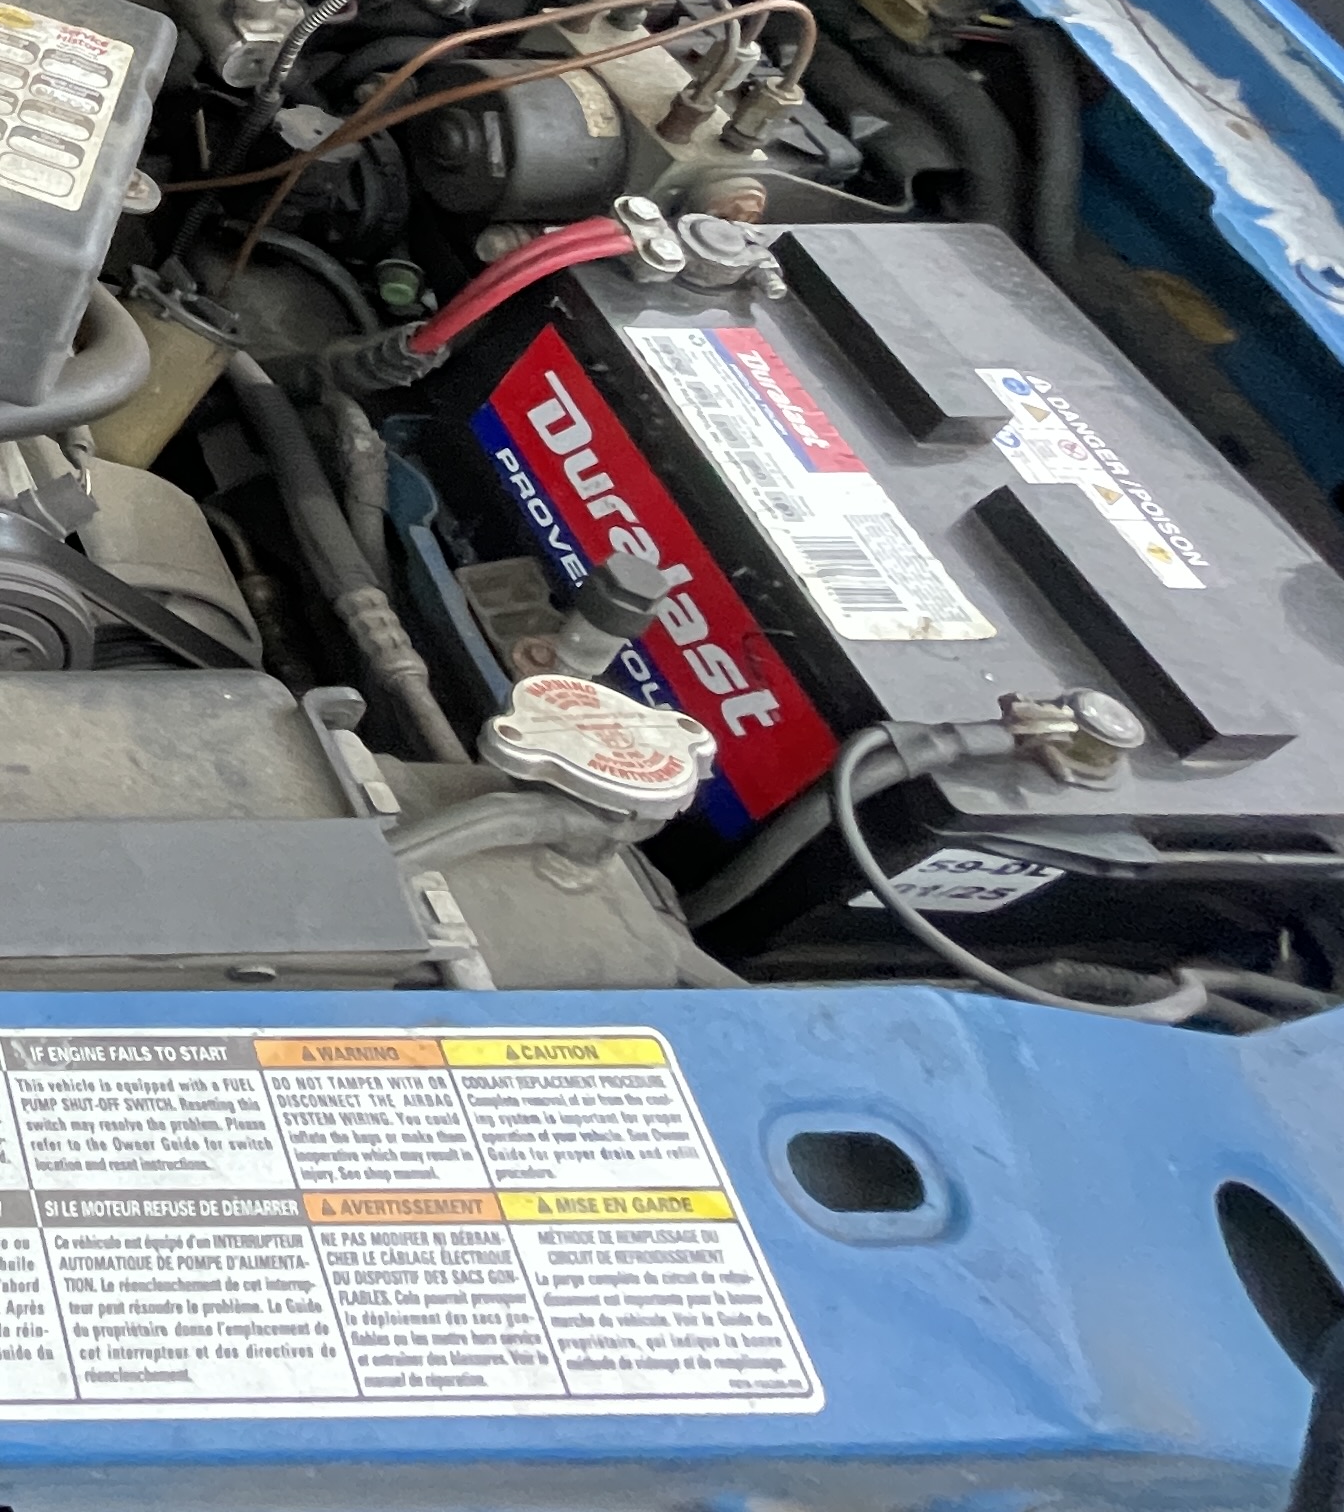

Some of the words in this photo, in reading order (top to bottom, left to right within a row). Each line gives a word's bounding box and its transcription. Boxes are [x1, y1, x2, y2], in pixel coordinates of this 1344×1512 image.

[1047, 397, 1130, 476] DANGER
[1129, 487, 1210, 567] POISON
[495, 447, 589, 588] PROVE
[30, 1047, 44, 1062] IF
[48, 1046, 106, 1062] ENGINE
[111, 1046, 153, 1062] FAILS
[154, 1046, 177, 1061] TO
[181, 1046, 228, 1061] START
[316, 1046, 400, 1061] WARNING
[521, 1045, 600, 1060] CAUTION
[271, 1076, 291, 1090] DO
[296, 1076, 322, 1090] NOT
[327, 1075, 384, 1090] TAMPER
[387, 1075, 424, 1090] WITH
[428, 1075, 447, 1089] OR
[277, 1094, 361, 1108] DISCONNECT
[368, 1094, 395, 1108] THE
[403, 1093, 454, 1108] AIRBAG
[44, 1200, 58, 1217] SI
[62, 1200, 78, 1217] LE
[81, 1200, 140, 1218] MOTEUR
[143, 1200, 196, 1217] REFUSE
[199, 1199, 219, 1216] DE
[222, 1196, 299, 1217] DÉMARRER
[340, 1198, 485, 1216] AVERTISSEMENT
[555, 1197, 599, 1214] MISE
[603, 1197, 628, 1214] EN
[632, 1197, 695, 1214] GARDE
